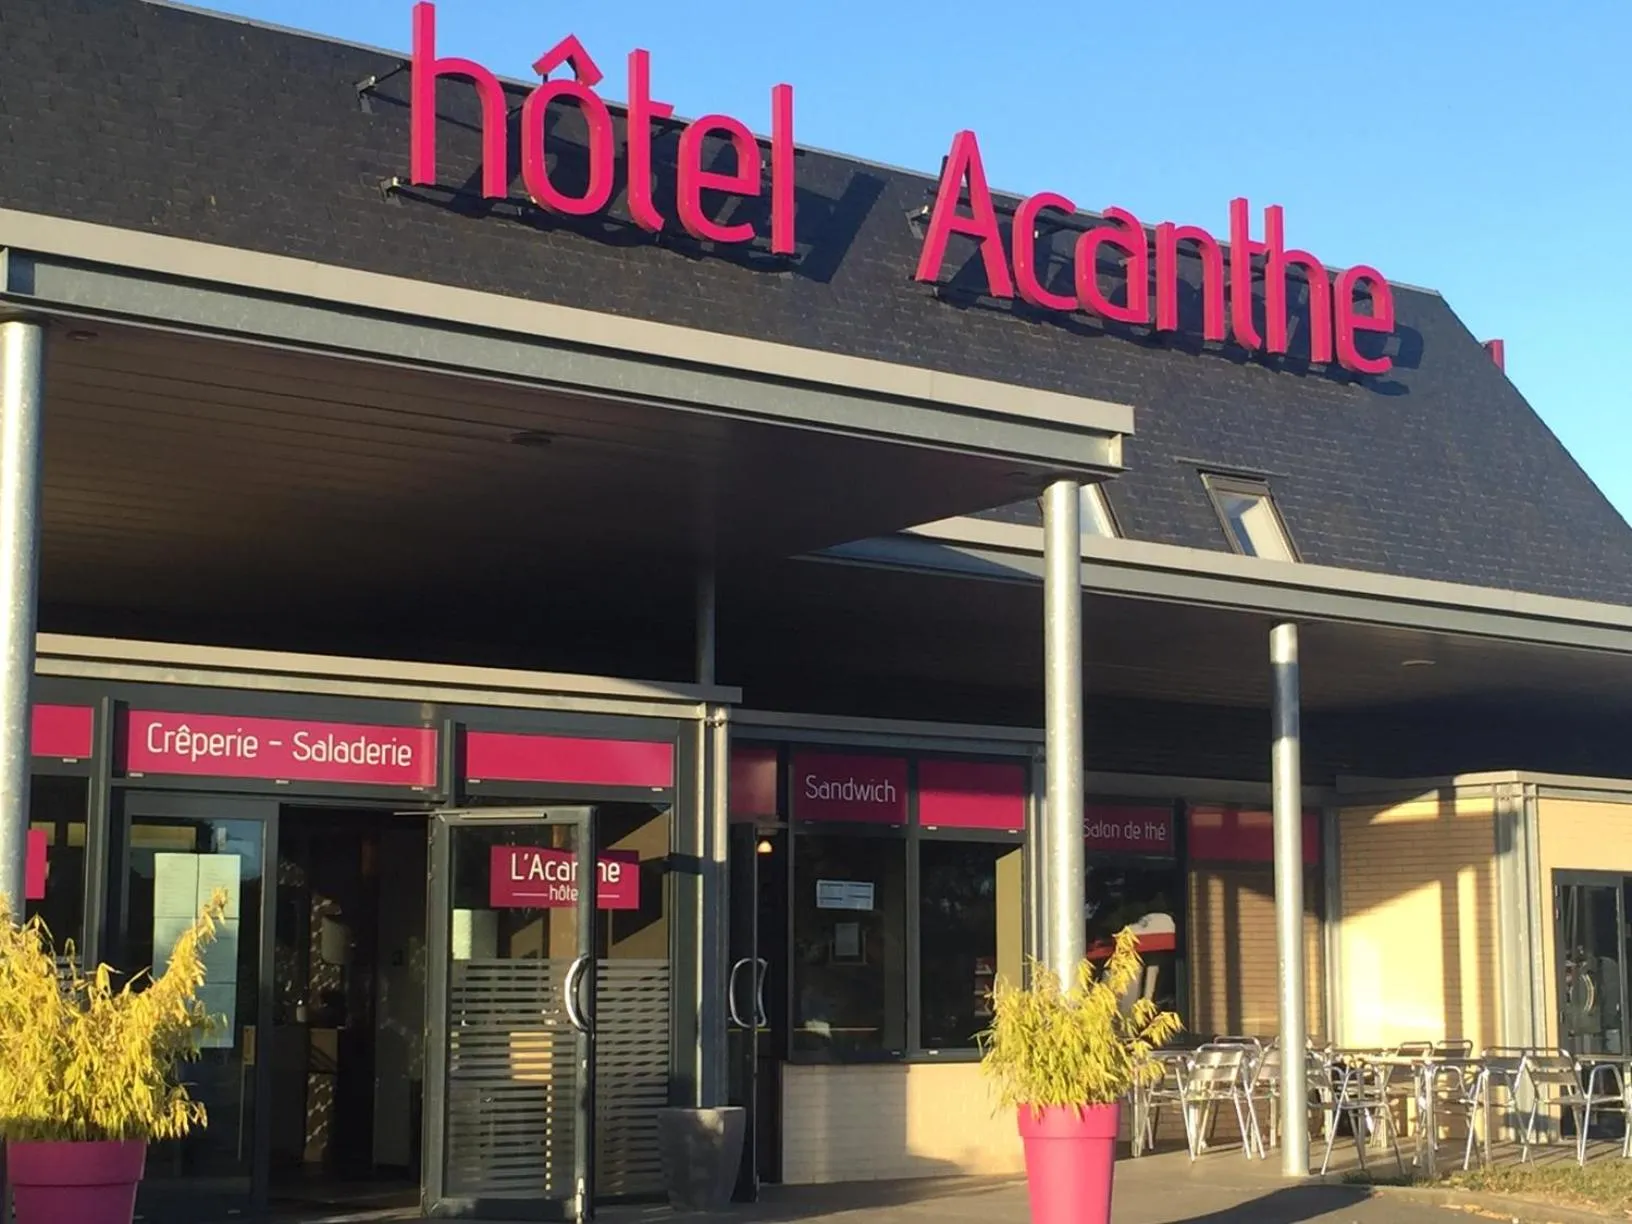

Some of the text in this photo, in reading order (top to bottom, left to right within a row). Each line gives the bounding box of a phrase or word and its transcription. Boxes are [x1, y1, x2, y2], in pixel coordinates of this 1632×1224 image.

[411, 1, 1395, 374] hôtel Acanthe
[147, 722, 258, 761] Crêperie
[292, 731, 412, 767] Saladerie
[805, 774, 896, 803] Sandwich
[1083, 817, 1166, 841] Salon de thé
[549, 884, 579, 901] hôte
